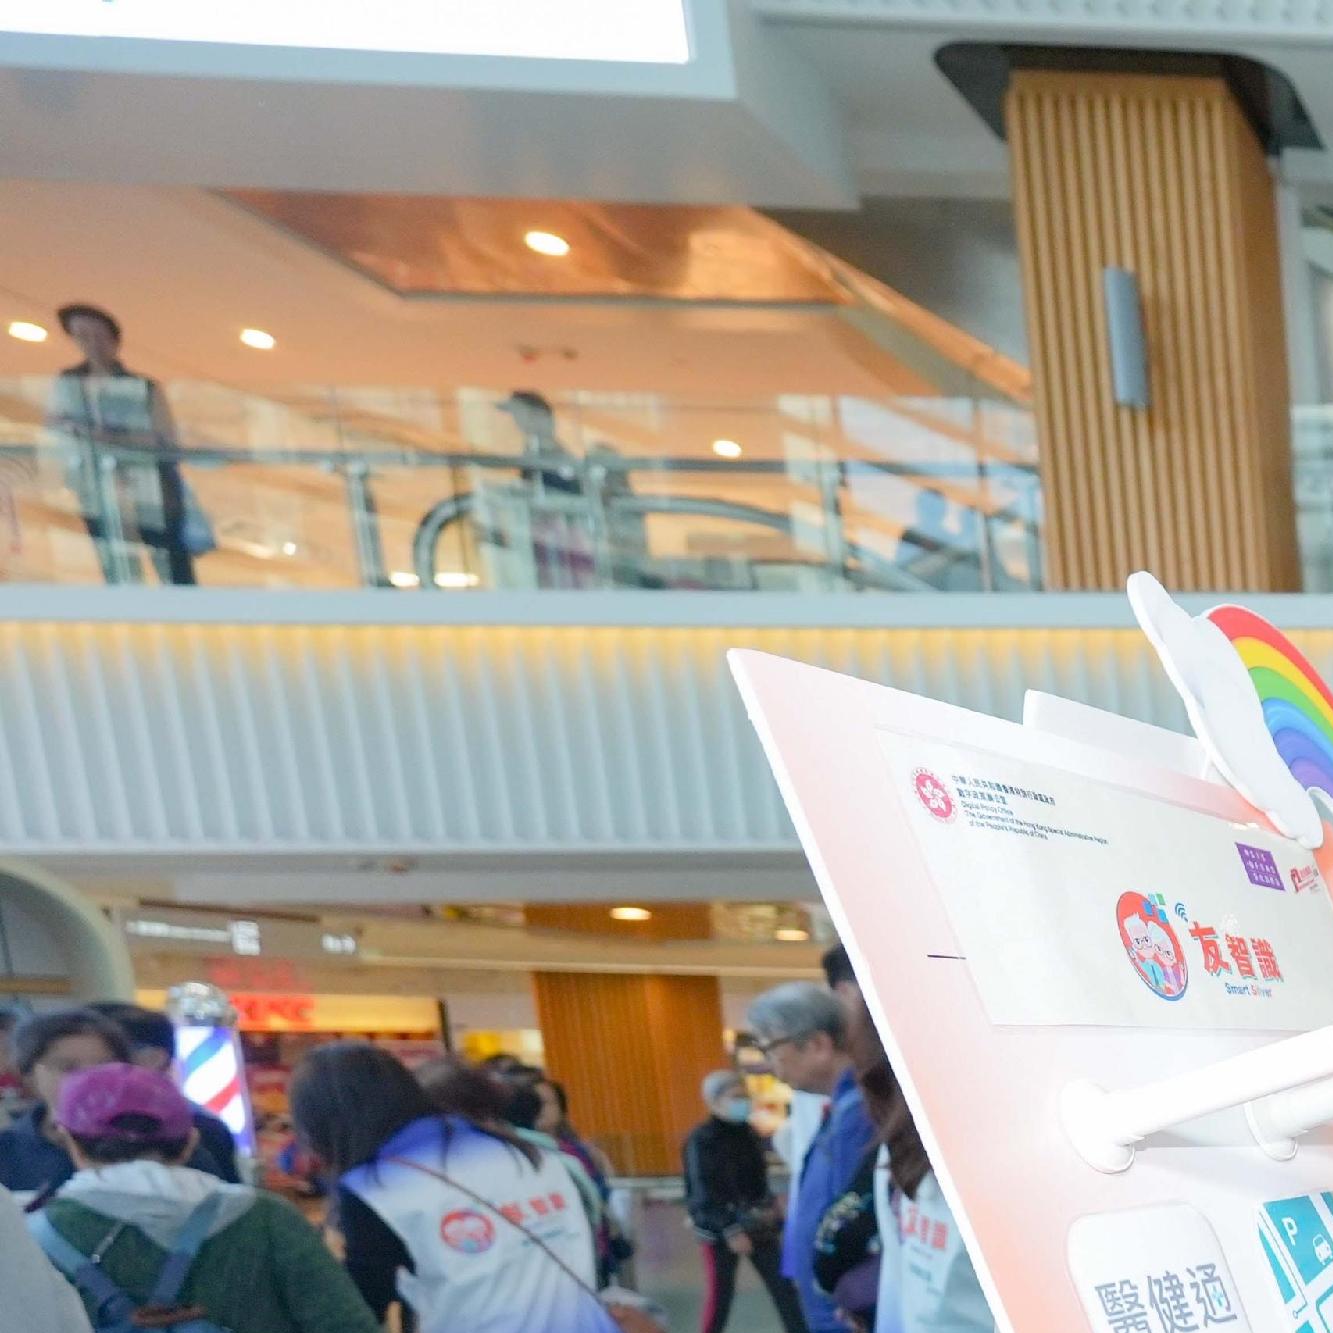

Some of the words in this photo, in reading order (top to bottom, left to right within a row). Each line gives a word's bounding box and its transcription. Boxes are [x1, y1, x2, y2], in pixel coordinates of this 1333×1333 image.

[1188, 920, 1285, 983] 友智識
[1224, 982, 1250, 997] Smart
